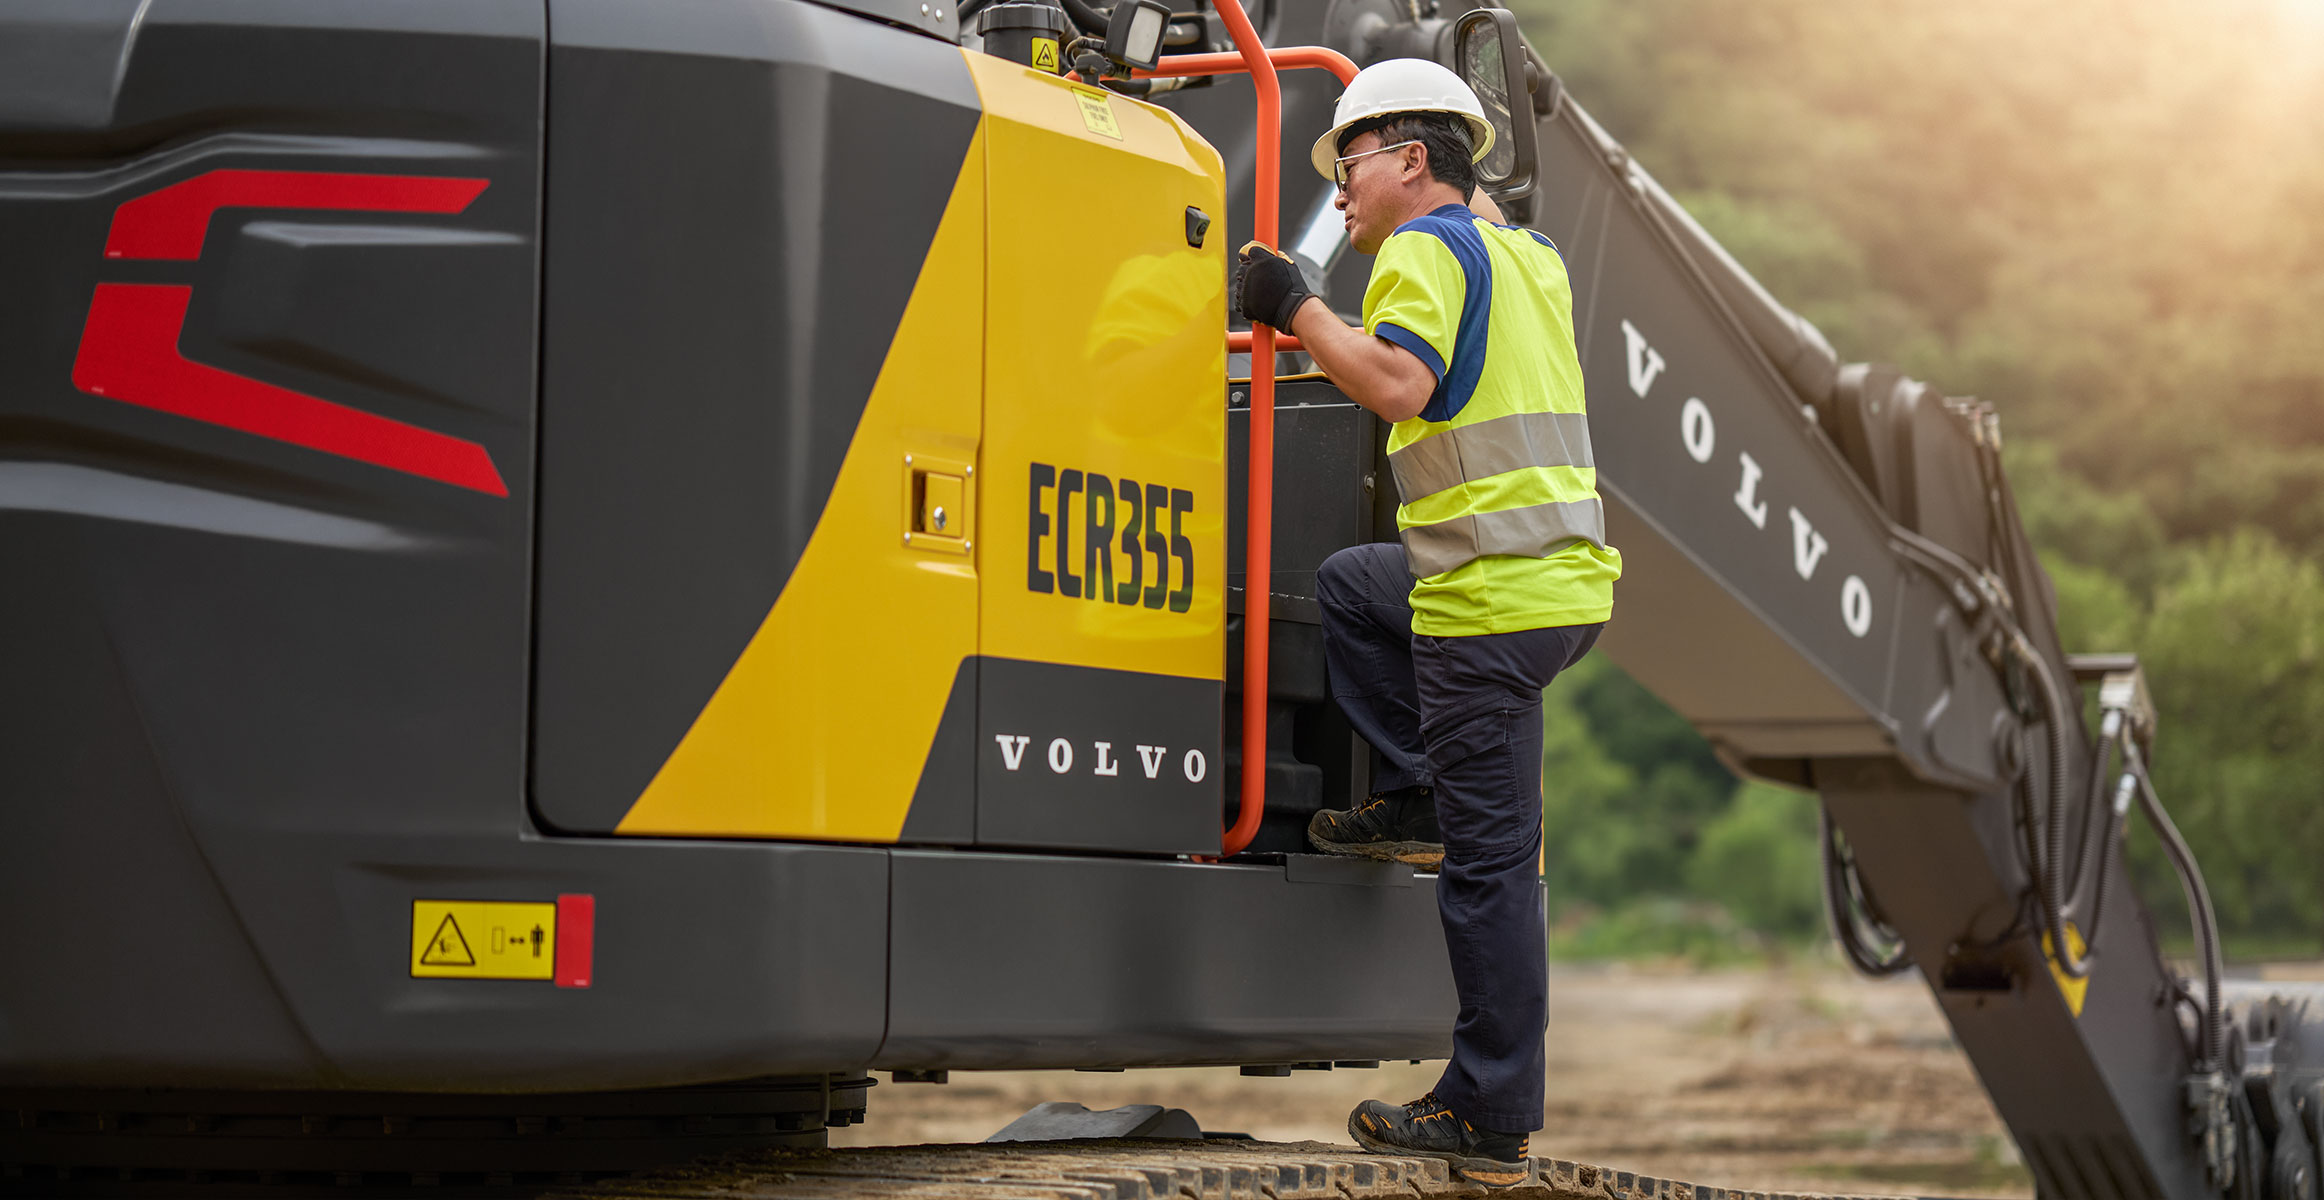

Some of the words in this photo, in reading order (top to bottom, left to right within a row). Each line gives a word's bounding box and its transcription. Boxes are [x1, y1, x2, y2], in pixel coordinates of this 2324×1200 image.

[1027, 461, 1194, 614] ECR355
[1621, 318, 1872, 638] VOLVO
[995, 734, 1206, 783] VOLVO
